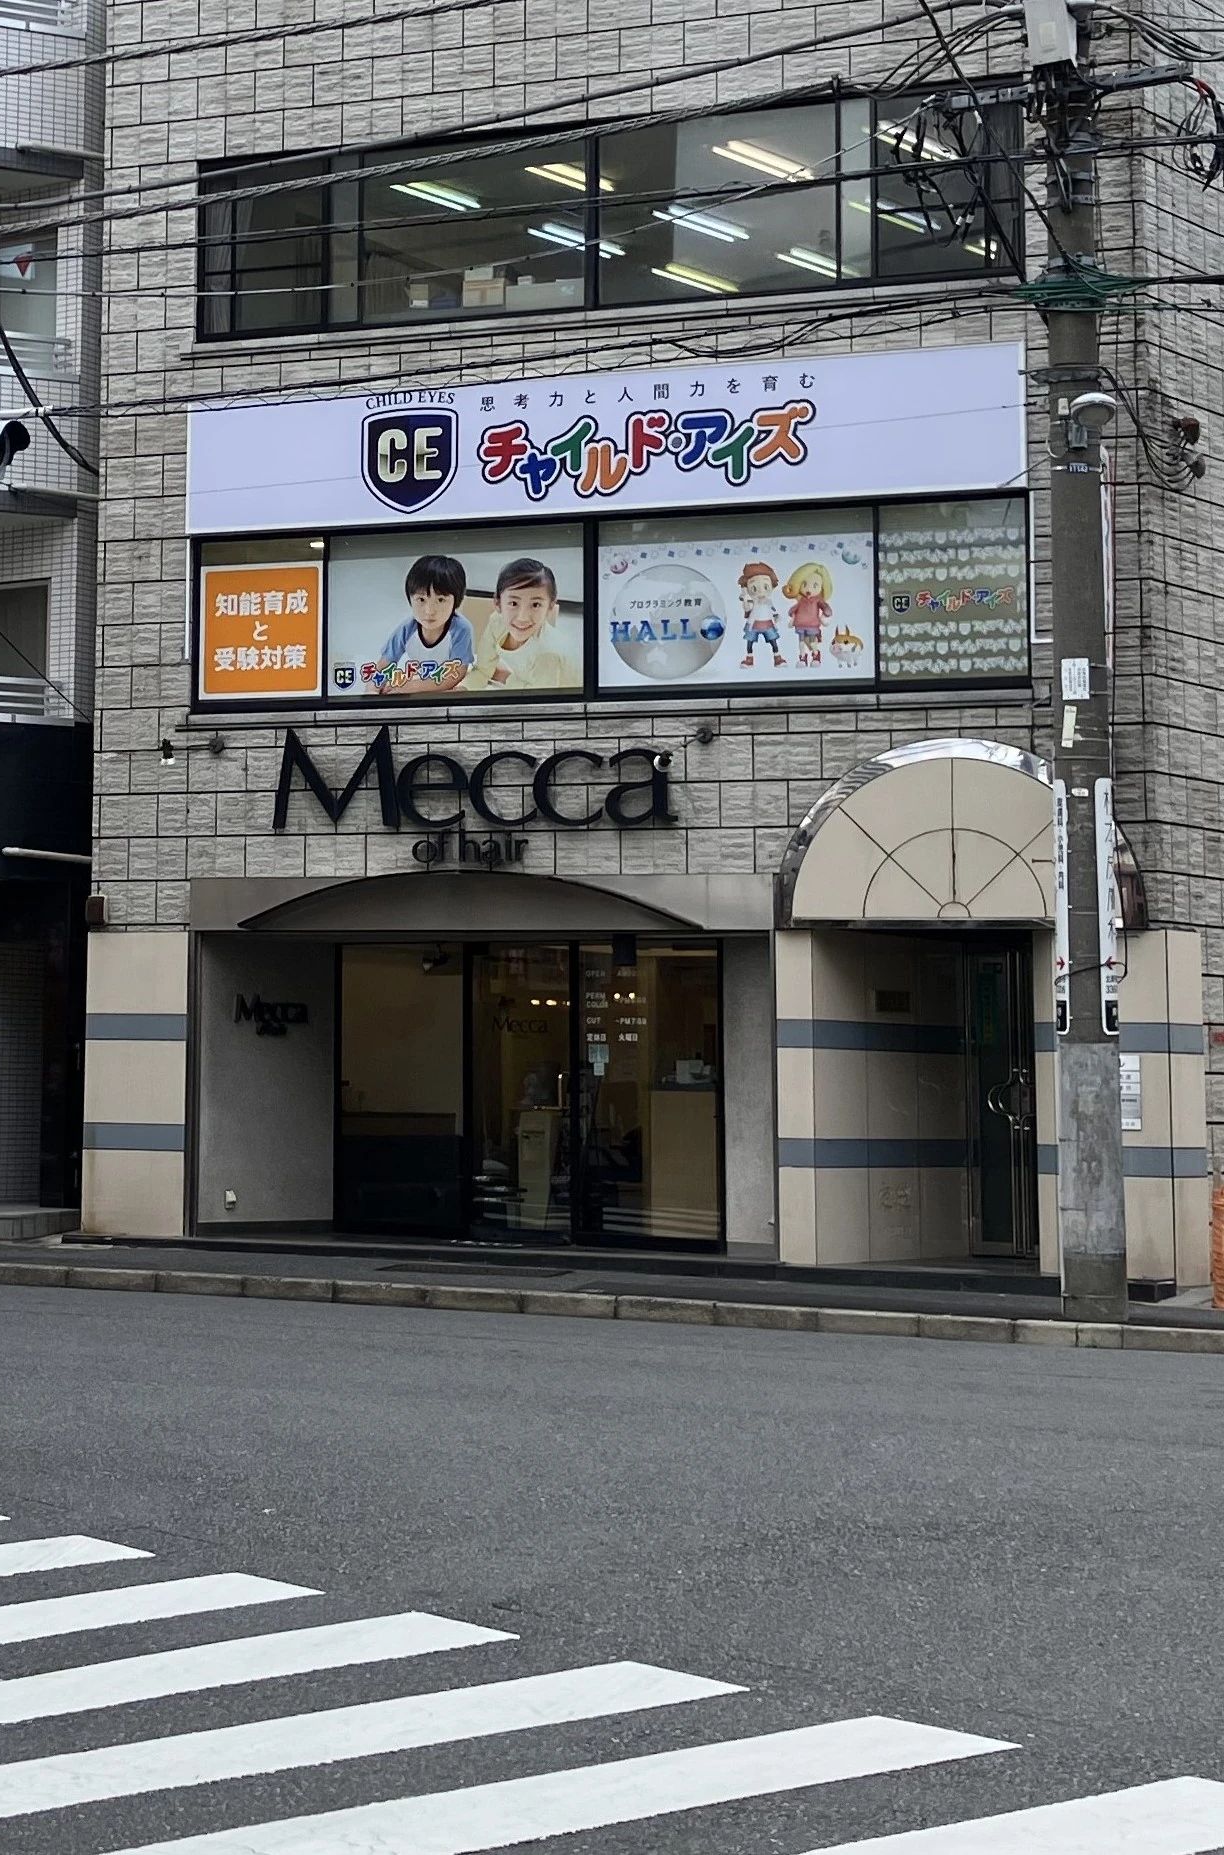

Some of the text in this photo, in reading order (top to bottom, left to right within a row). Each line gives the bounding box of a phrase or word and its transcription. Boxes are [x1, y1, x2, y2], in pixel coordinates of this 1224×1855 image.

[365, 391, 456, 410] CHILD EYES
[479, 373, 816, 412] 思考力と人間力を育む
[377, 427, 443, 483] CE
[479, 400, 815, 499] チャイルド・アイズ
[215, 589, 309, 617] 知能育成
[629, 598, 703, 610] プログラミング教育
[251, 621, 270, 642] と
[214, 645, 308, 672] 受験対策
[336, 669, 353, 684] CE
[272, 725, 679, 830] Mecca
[412, 829, 529, 866] of hair
